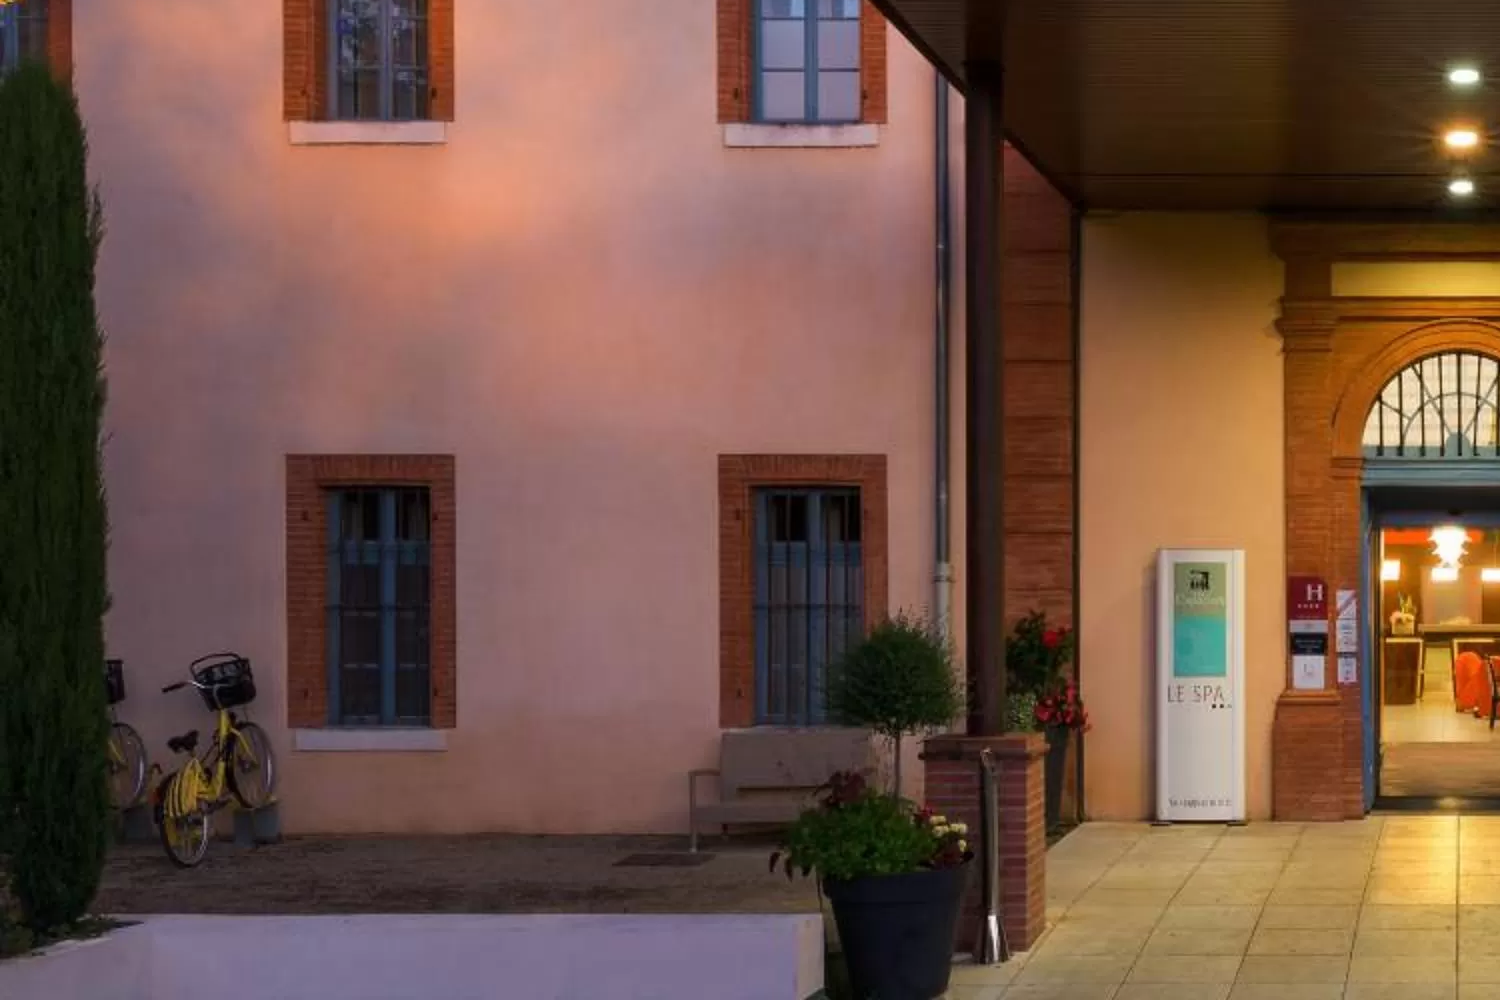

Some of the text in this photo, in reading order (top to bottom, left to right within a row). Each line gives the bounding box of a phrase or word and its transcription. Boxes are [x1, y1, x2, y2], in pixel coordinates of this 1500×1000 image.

[1307, 584, 1323, 601] H
[1167, 684, 1225, 703] LE SPA
